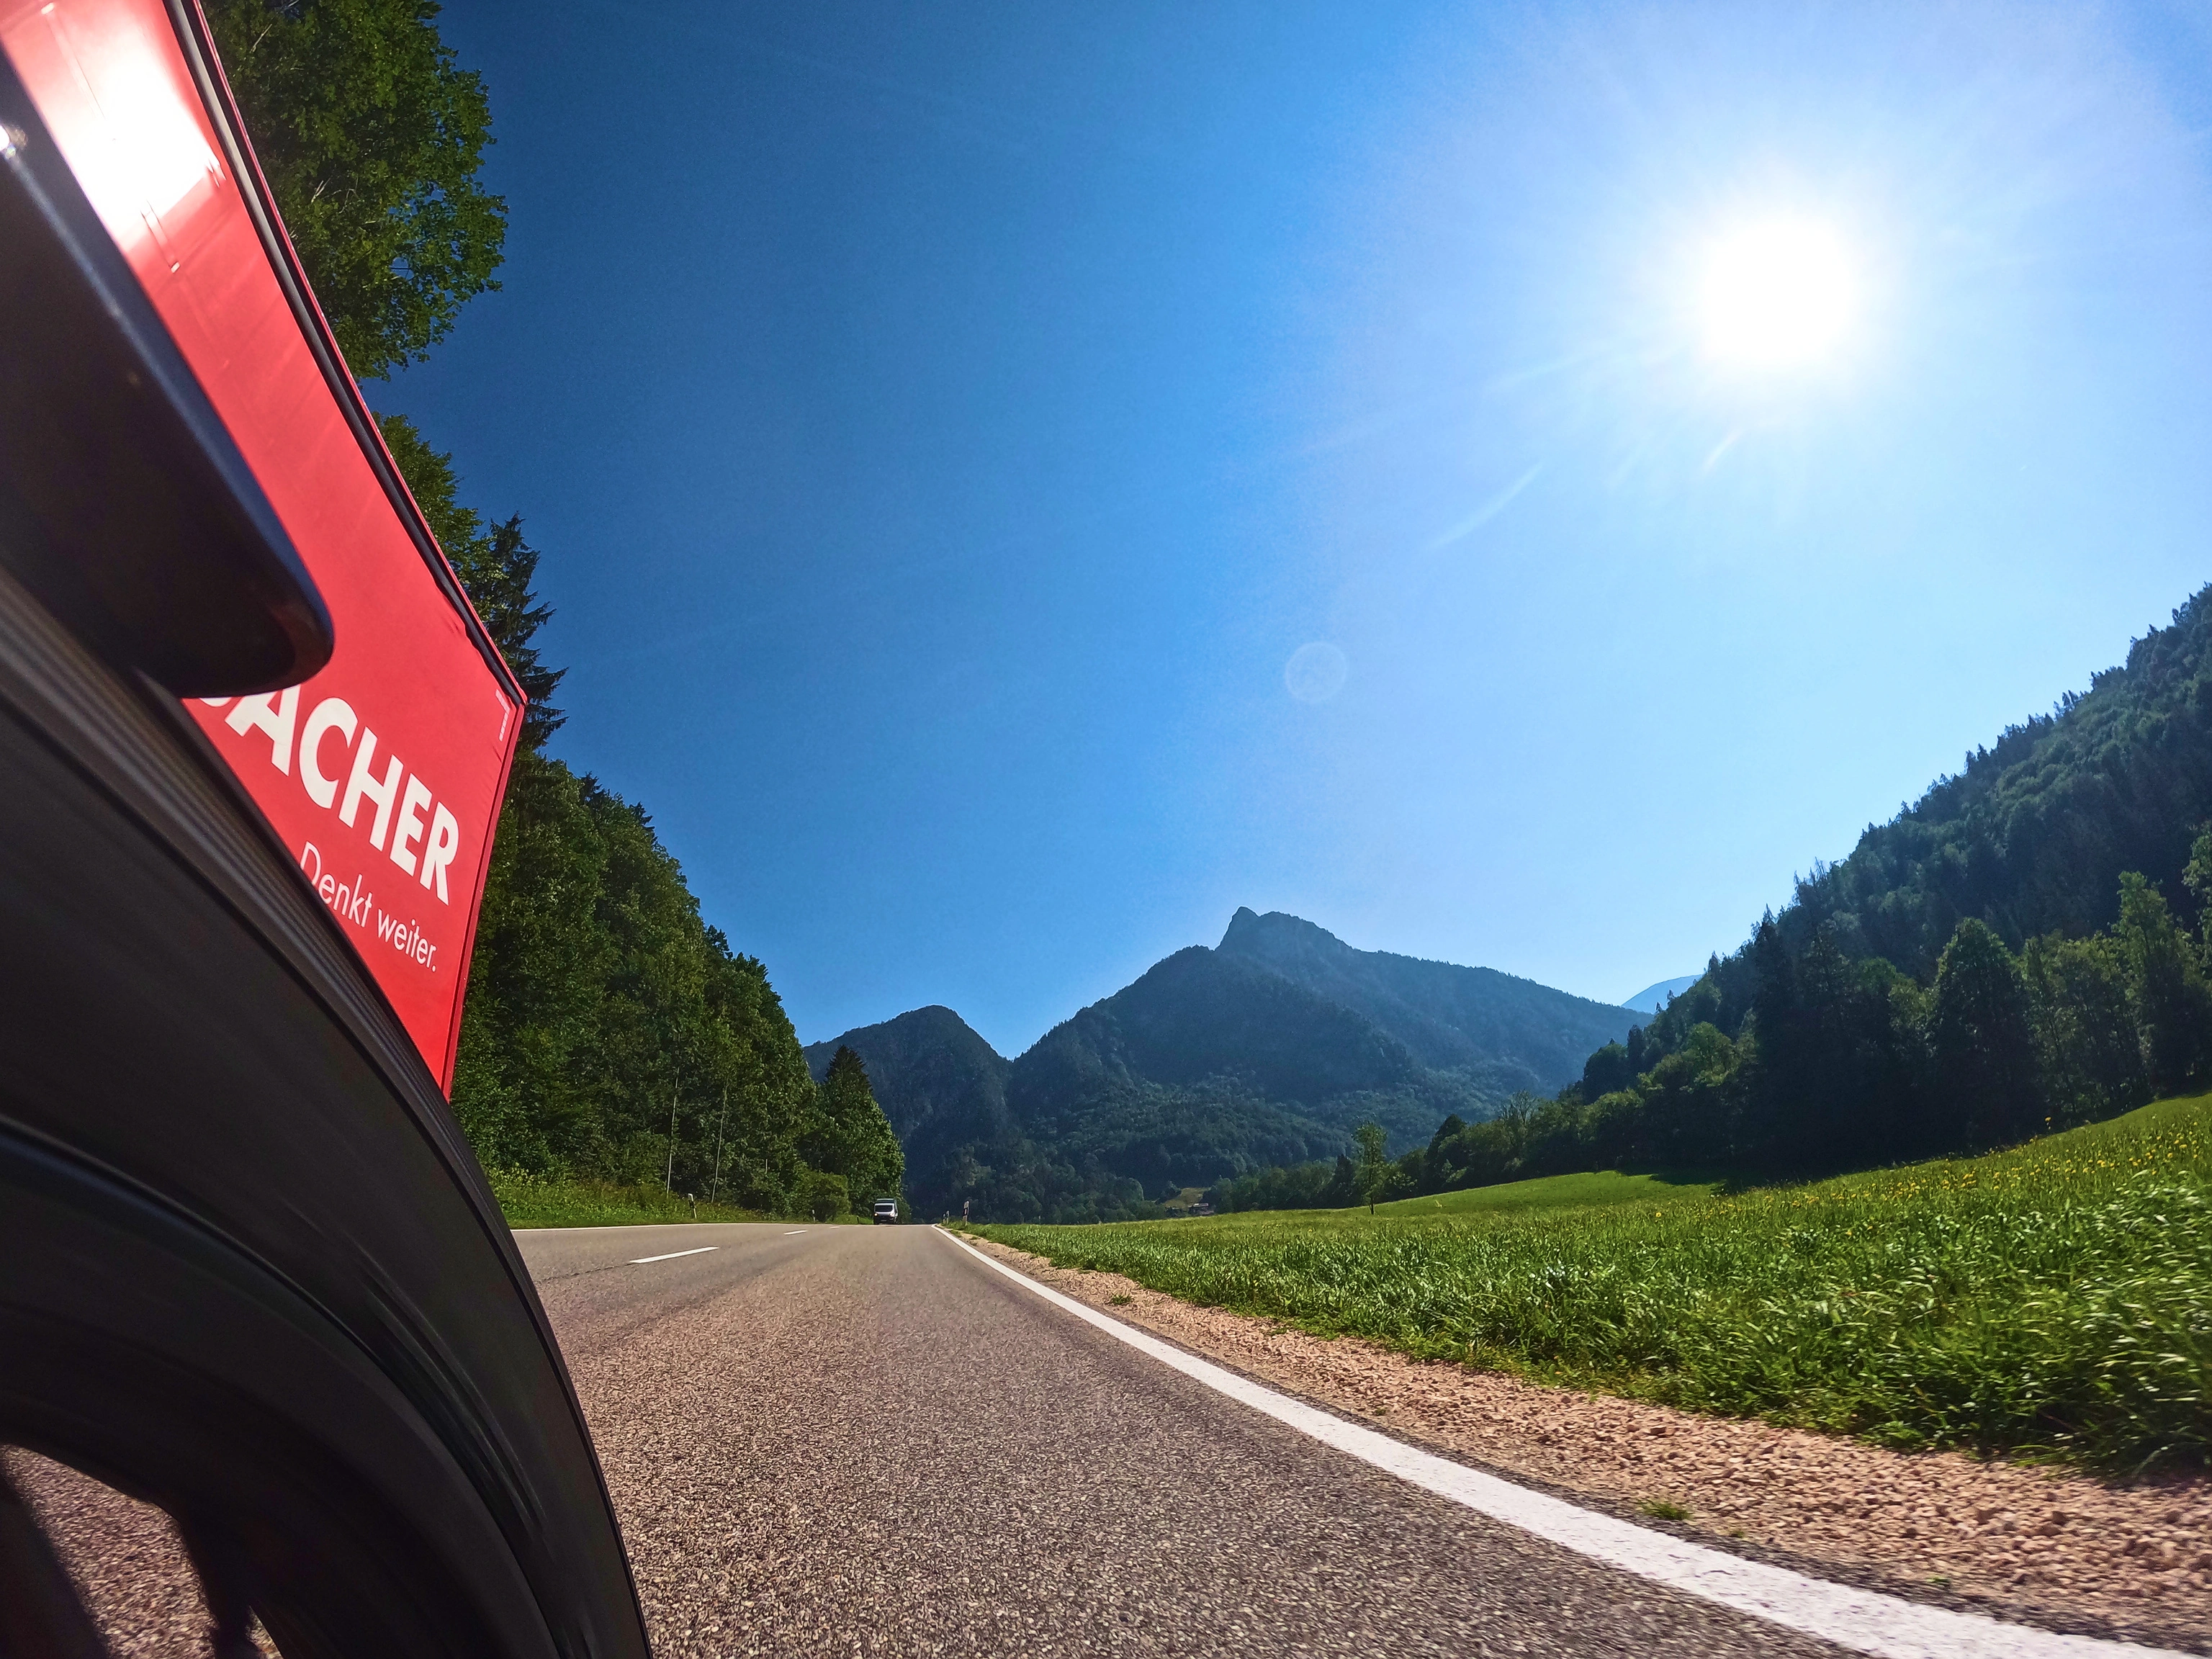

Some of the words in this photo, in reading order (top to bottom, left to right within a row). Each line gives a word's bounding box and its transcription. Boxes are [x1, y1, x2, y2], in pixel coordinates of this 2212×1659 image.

[199, 683, 459, 906] ACHER
[300, 840, 373, 928] Denkt
[377, 907, 438, 972] weiter.
